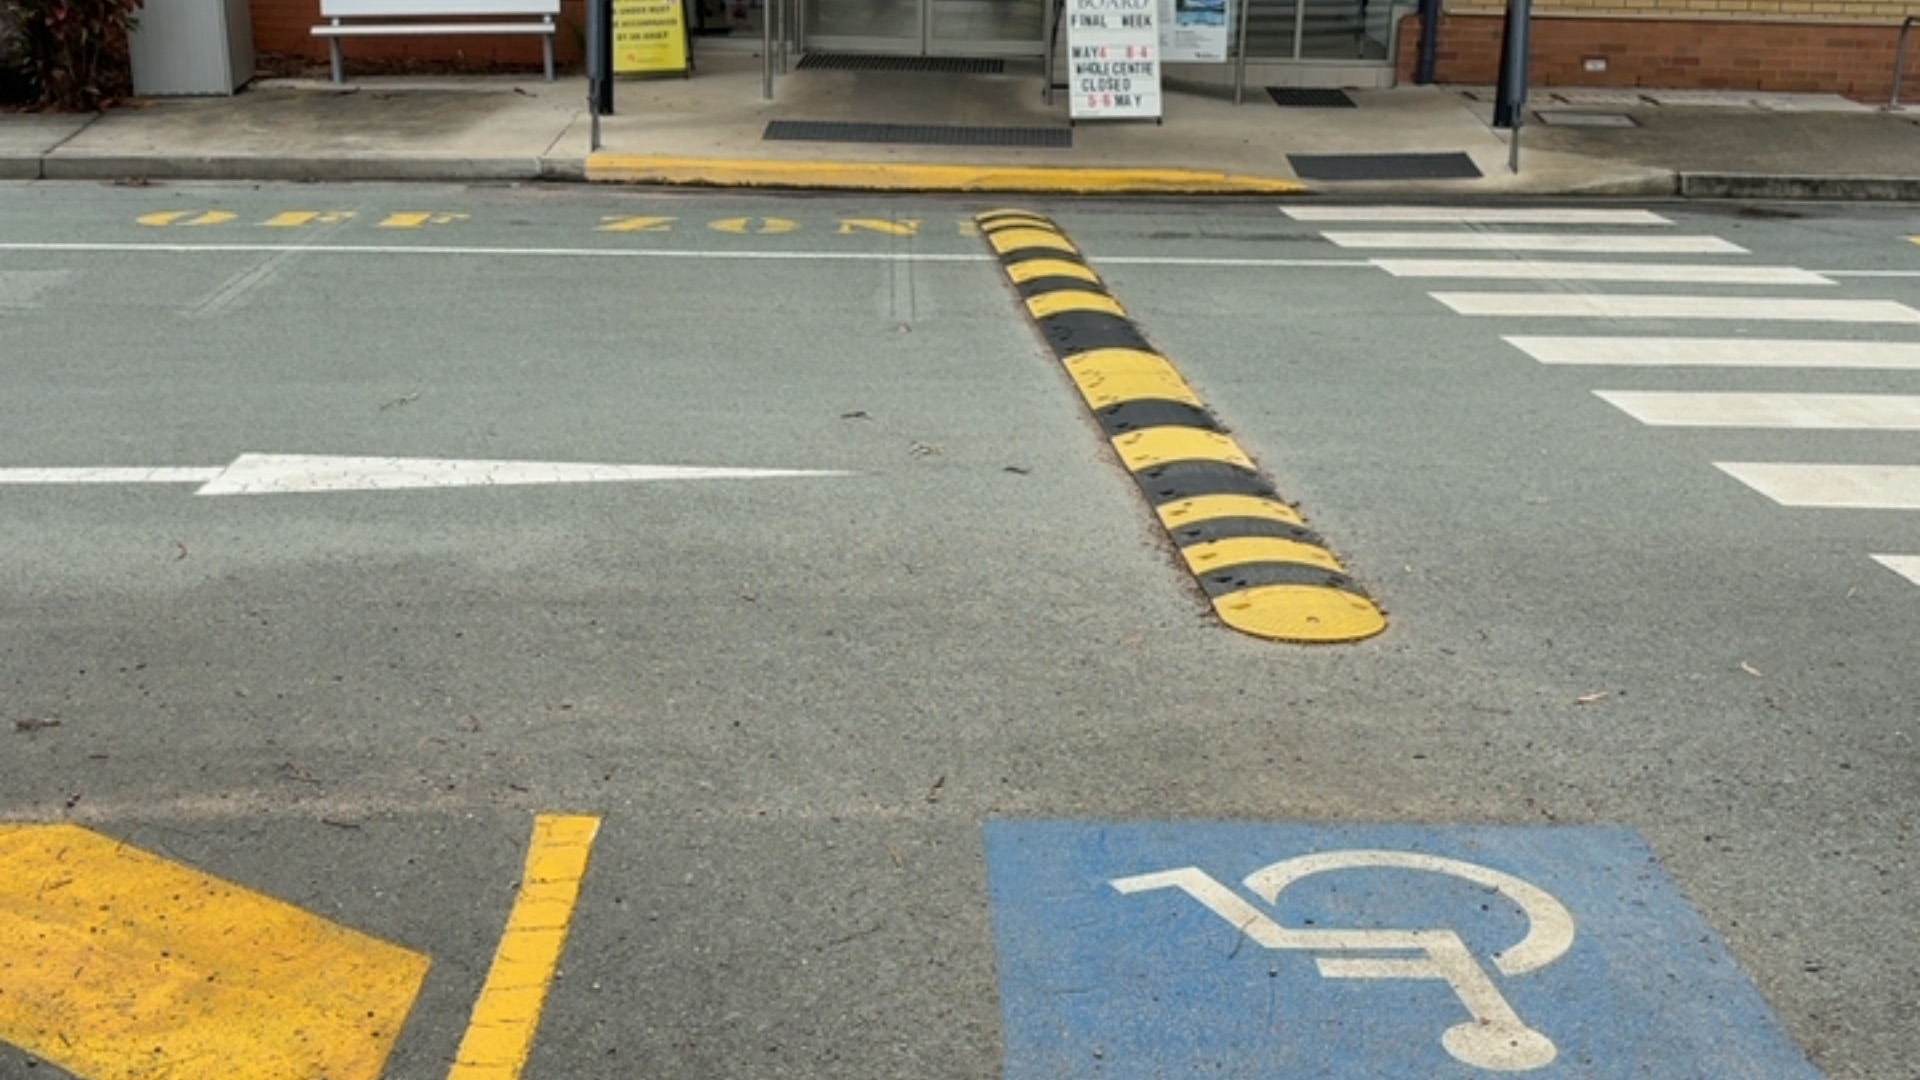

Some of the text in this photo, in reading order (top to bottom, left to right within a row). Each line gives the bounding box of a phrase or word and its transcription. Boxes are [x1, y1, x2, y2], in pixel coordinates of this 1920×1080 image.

[1071, 14, 1152, 28] FINAL WEEK
[1112, 62, 1153, 76] CENTRE
[1082, 78, 1131, 92] CLOSED
[1114, 93, 1143, 107] MAY
[591, 214, 981, 238] ZON
